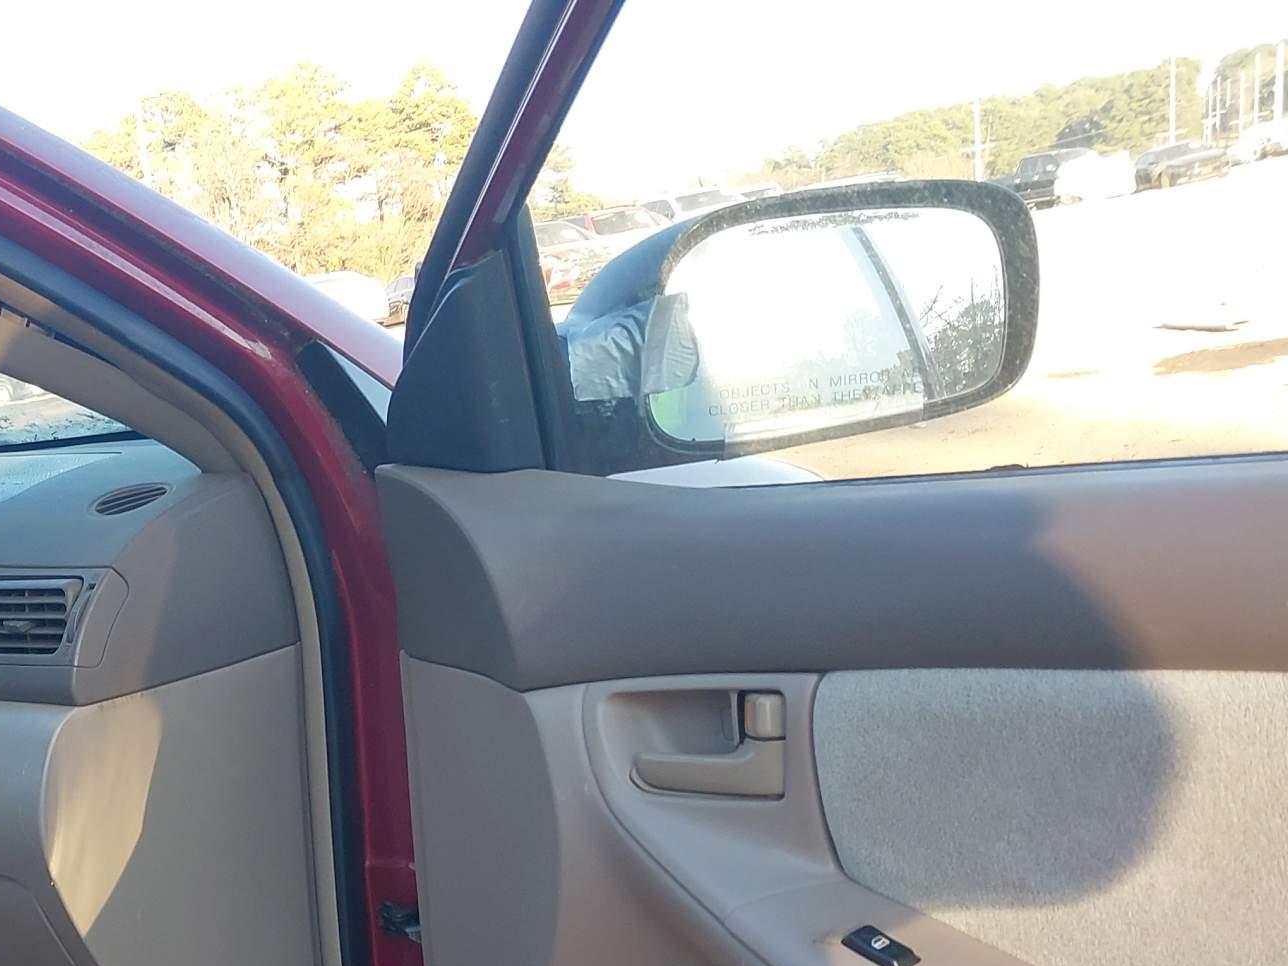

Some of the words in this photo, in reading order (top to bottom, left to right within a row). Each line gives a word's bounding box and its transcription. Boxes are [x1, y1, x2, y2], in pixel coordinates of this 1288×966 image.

[720, 383, 791, 400] OBJECTS
[830, 368, 890, 387] MIRROR
[708, 399, 770, 417] CLOSER
